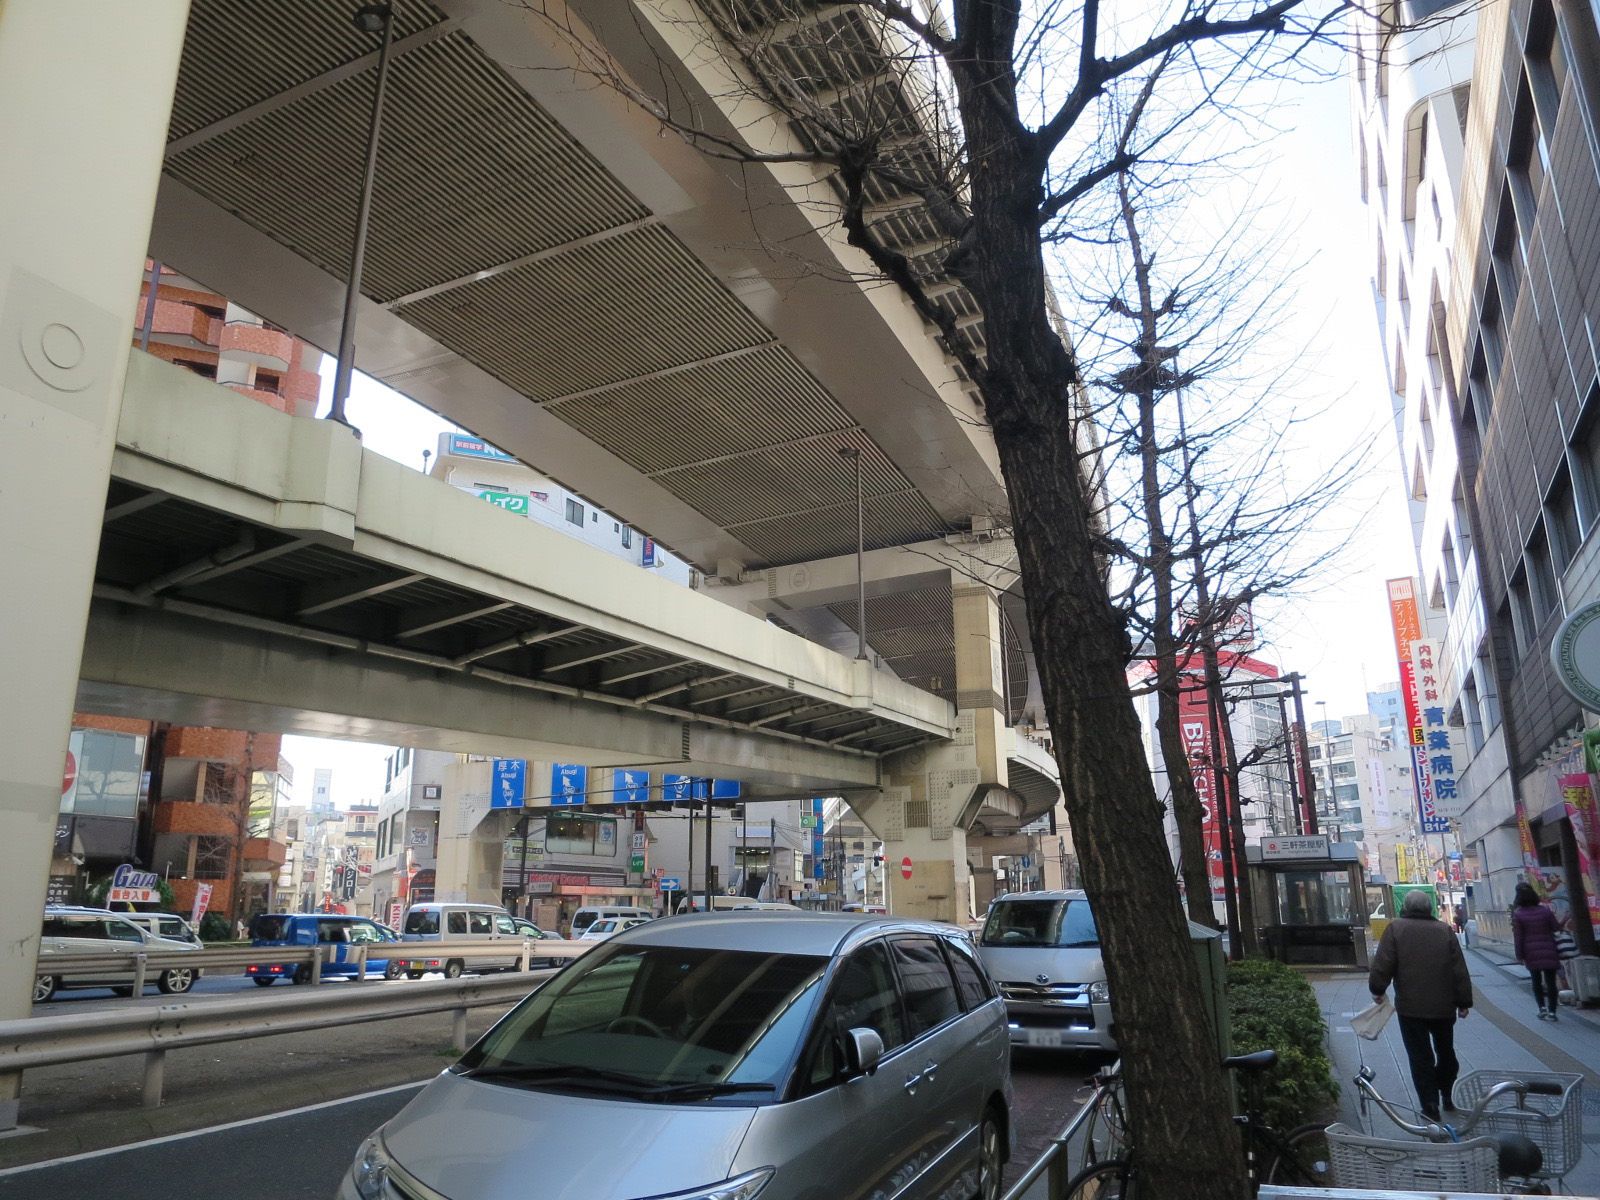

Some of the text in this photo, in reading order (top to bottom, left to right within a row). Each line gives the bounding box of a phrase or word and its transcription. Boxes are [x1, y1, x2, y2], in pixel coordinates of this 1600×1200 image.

[1560, 638, 1572, 670] HEALTHY
[1423, 705, 1458, 800] 青葉病院
[498, 760, 520, 771] 厚木
[1281, 839, 1325, 850] 三軒茶屋駅
[114, 864, 156, 888] GAIA
